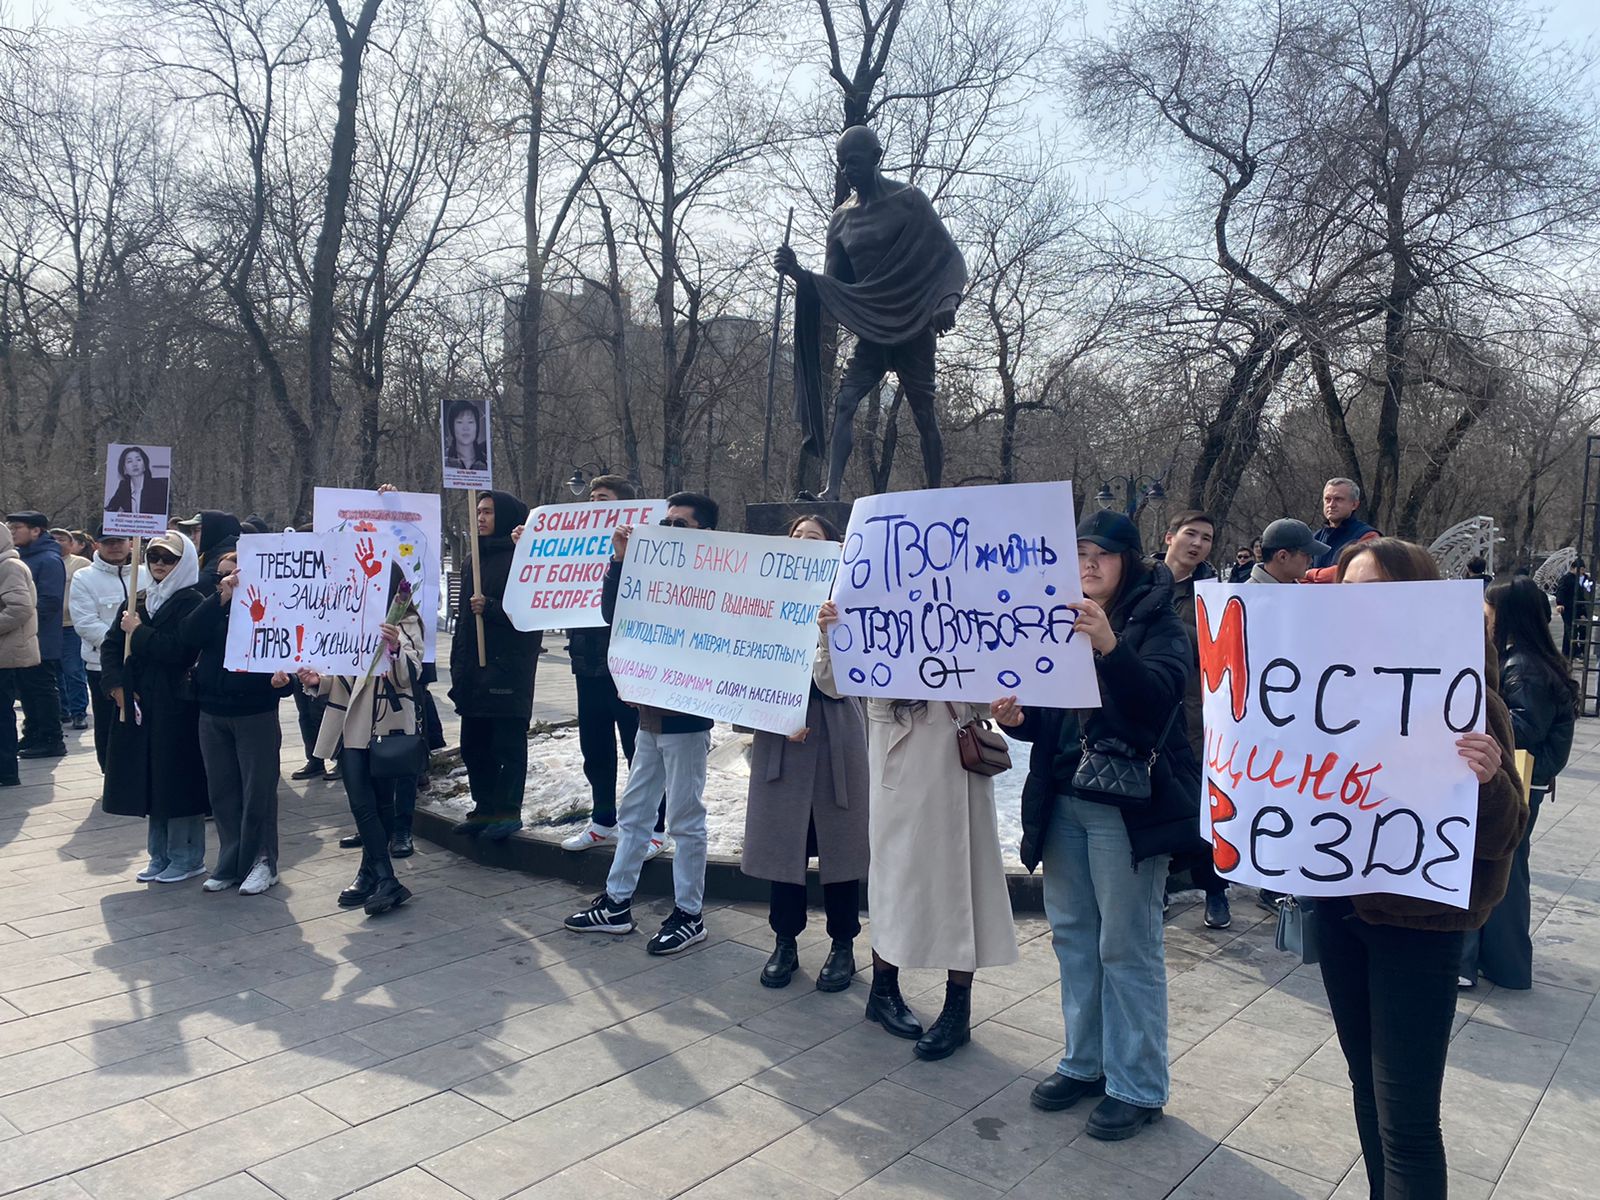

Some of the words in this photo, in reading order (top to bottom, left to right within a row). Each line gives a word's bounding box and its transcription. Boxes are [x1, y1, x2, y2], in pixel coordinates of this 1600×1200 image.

[256, 550, 327, 580] ТРЕБУЕМ
[519, 564, 545, 583] ОТ
[634, 538, 686, 568] ПУСТЬ
[693, 544, 748, 574] БАНКИ
[760, 552, 839, 583] ОТВЕЧАЮТ
[865, 514, 970, 593] ТВОЯ
[620, 576, 642, 601] ЗА
[647, 580, 716, 611] НЕЗАКОННО
[721, 592, 775, 619] ВЫДАННЫЕ
[615, 618, 685, 648] МНОГОДЕТНЫМ
[733, 639, 809, 672] БЕЗРАБОТНЫМ,
[845, 606, 915, 659] ТВОЯ
[921, 602, 1079, 654] СВОБОДА
[660, 667, 713, 693] УЯЗВИМЫМ
[716, 680, 747, 700] СЛОЯМ
[748, 686, 803, 708] НАСЕЛЕНИЯ
[665, 691, 744, 721] ЕВРАЗИЙСКИЙ
